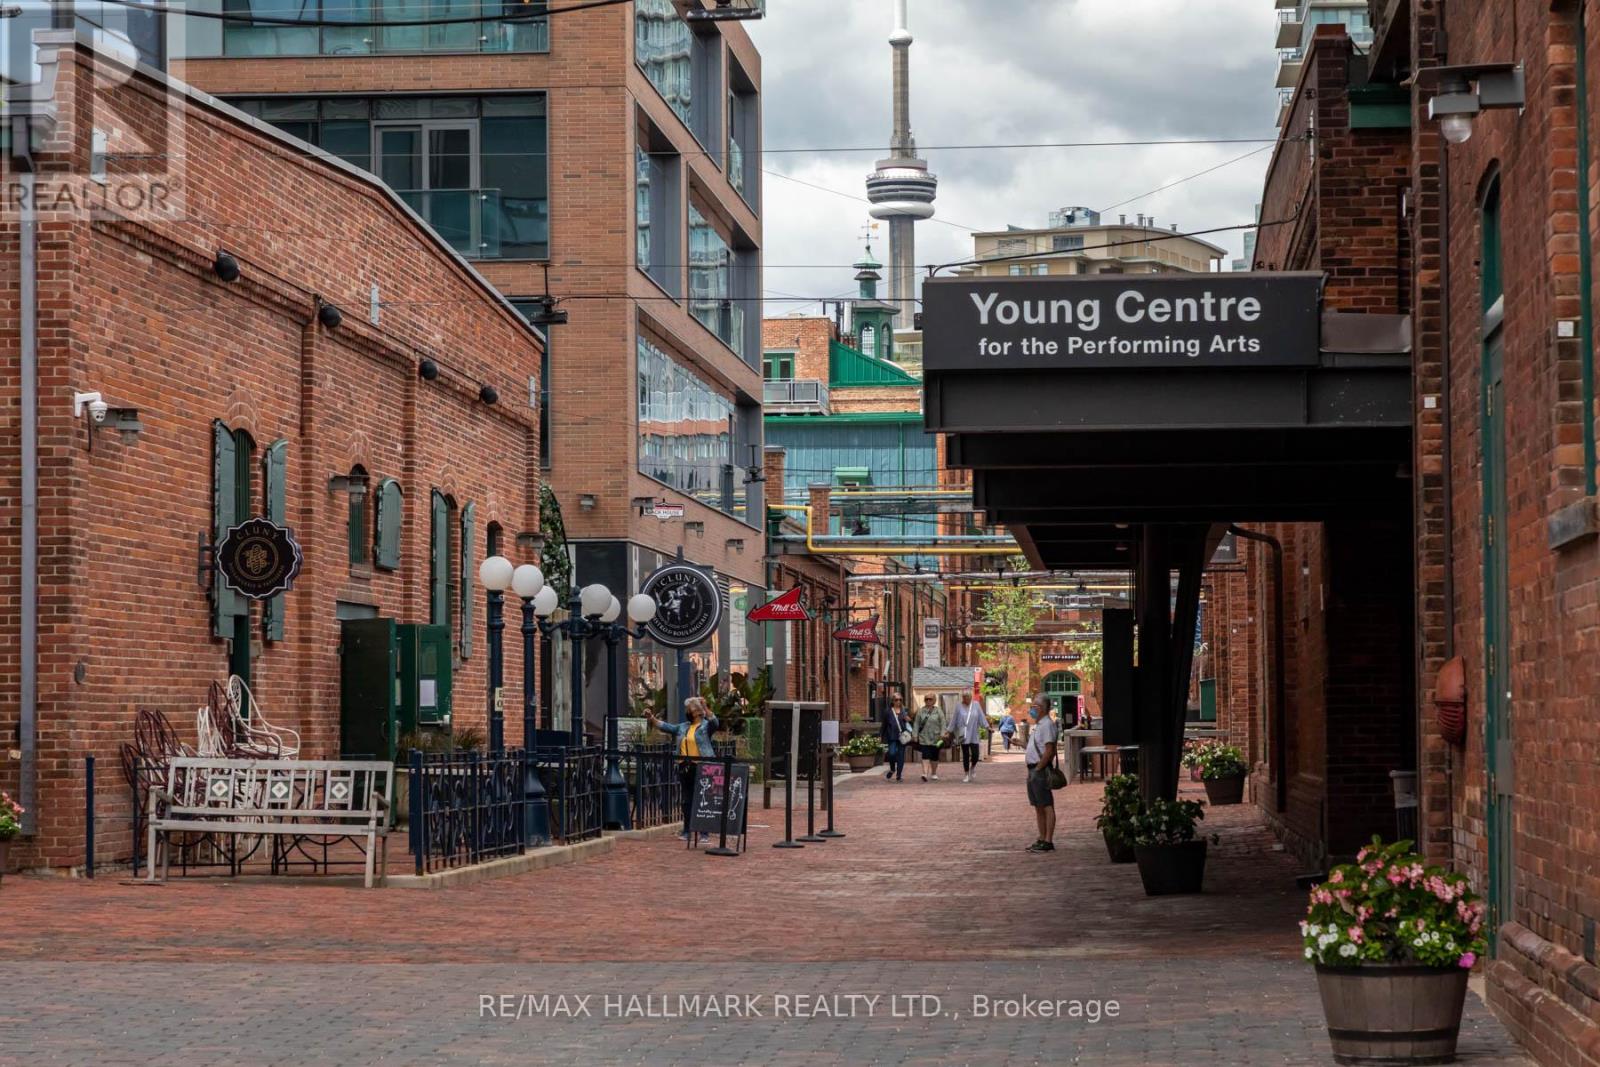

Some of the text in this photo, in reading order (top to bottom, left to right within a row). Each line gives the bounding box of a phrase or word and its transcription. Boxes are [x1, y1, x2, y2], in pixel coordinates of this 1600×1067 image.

[969, 290, 1262, 331] Young Centre
[978, 334, 1261, 357] for the Performing Arts
[236, 527, 280, 540] CLUNY
[660, 573, 700, 586] CLUNY
[770, 603, 789, 612] Mill
